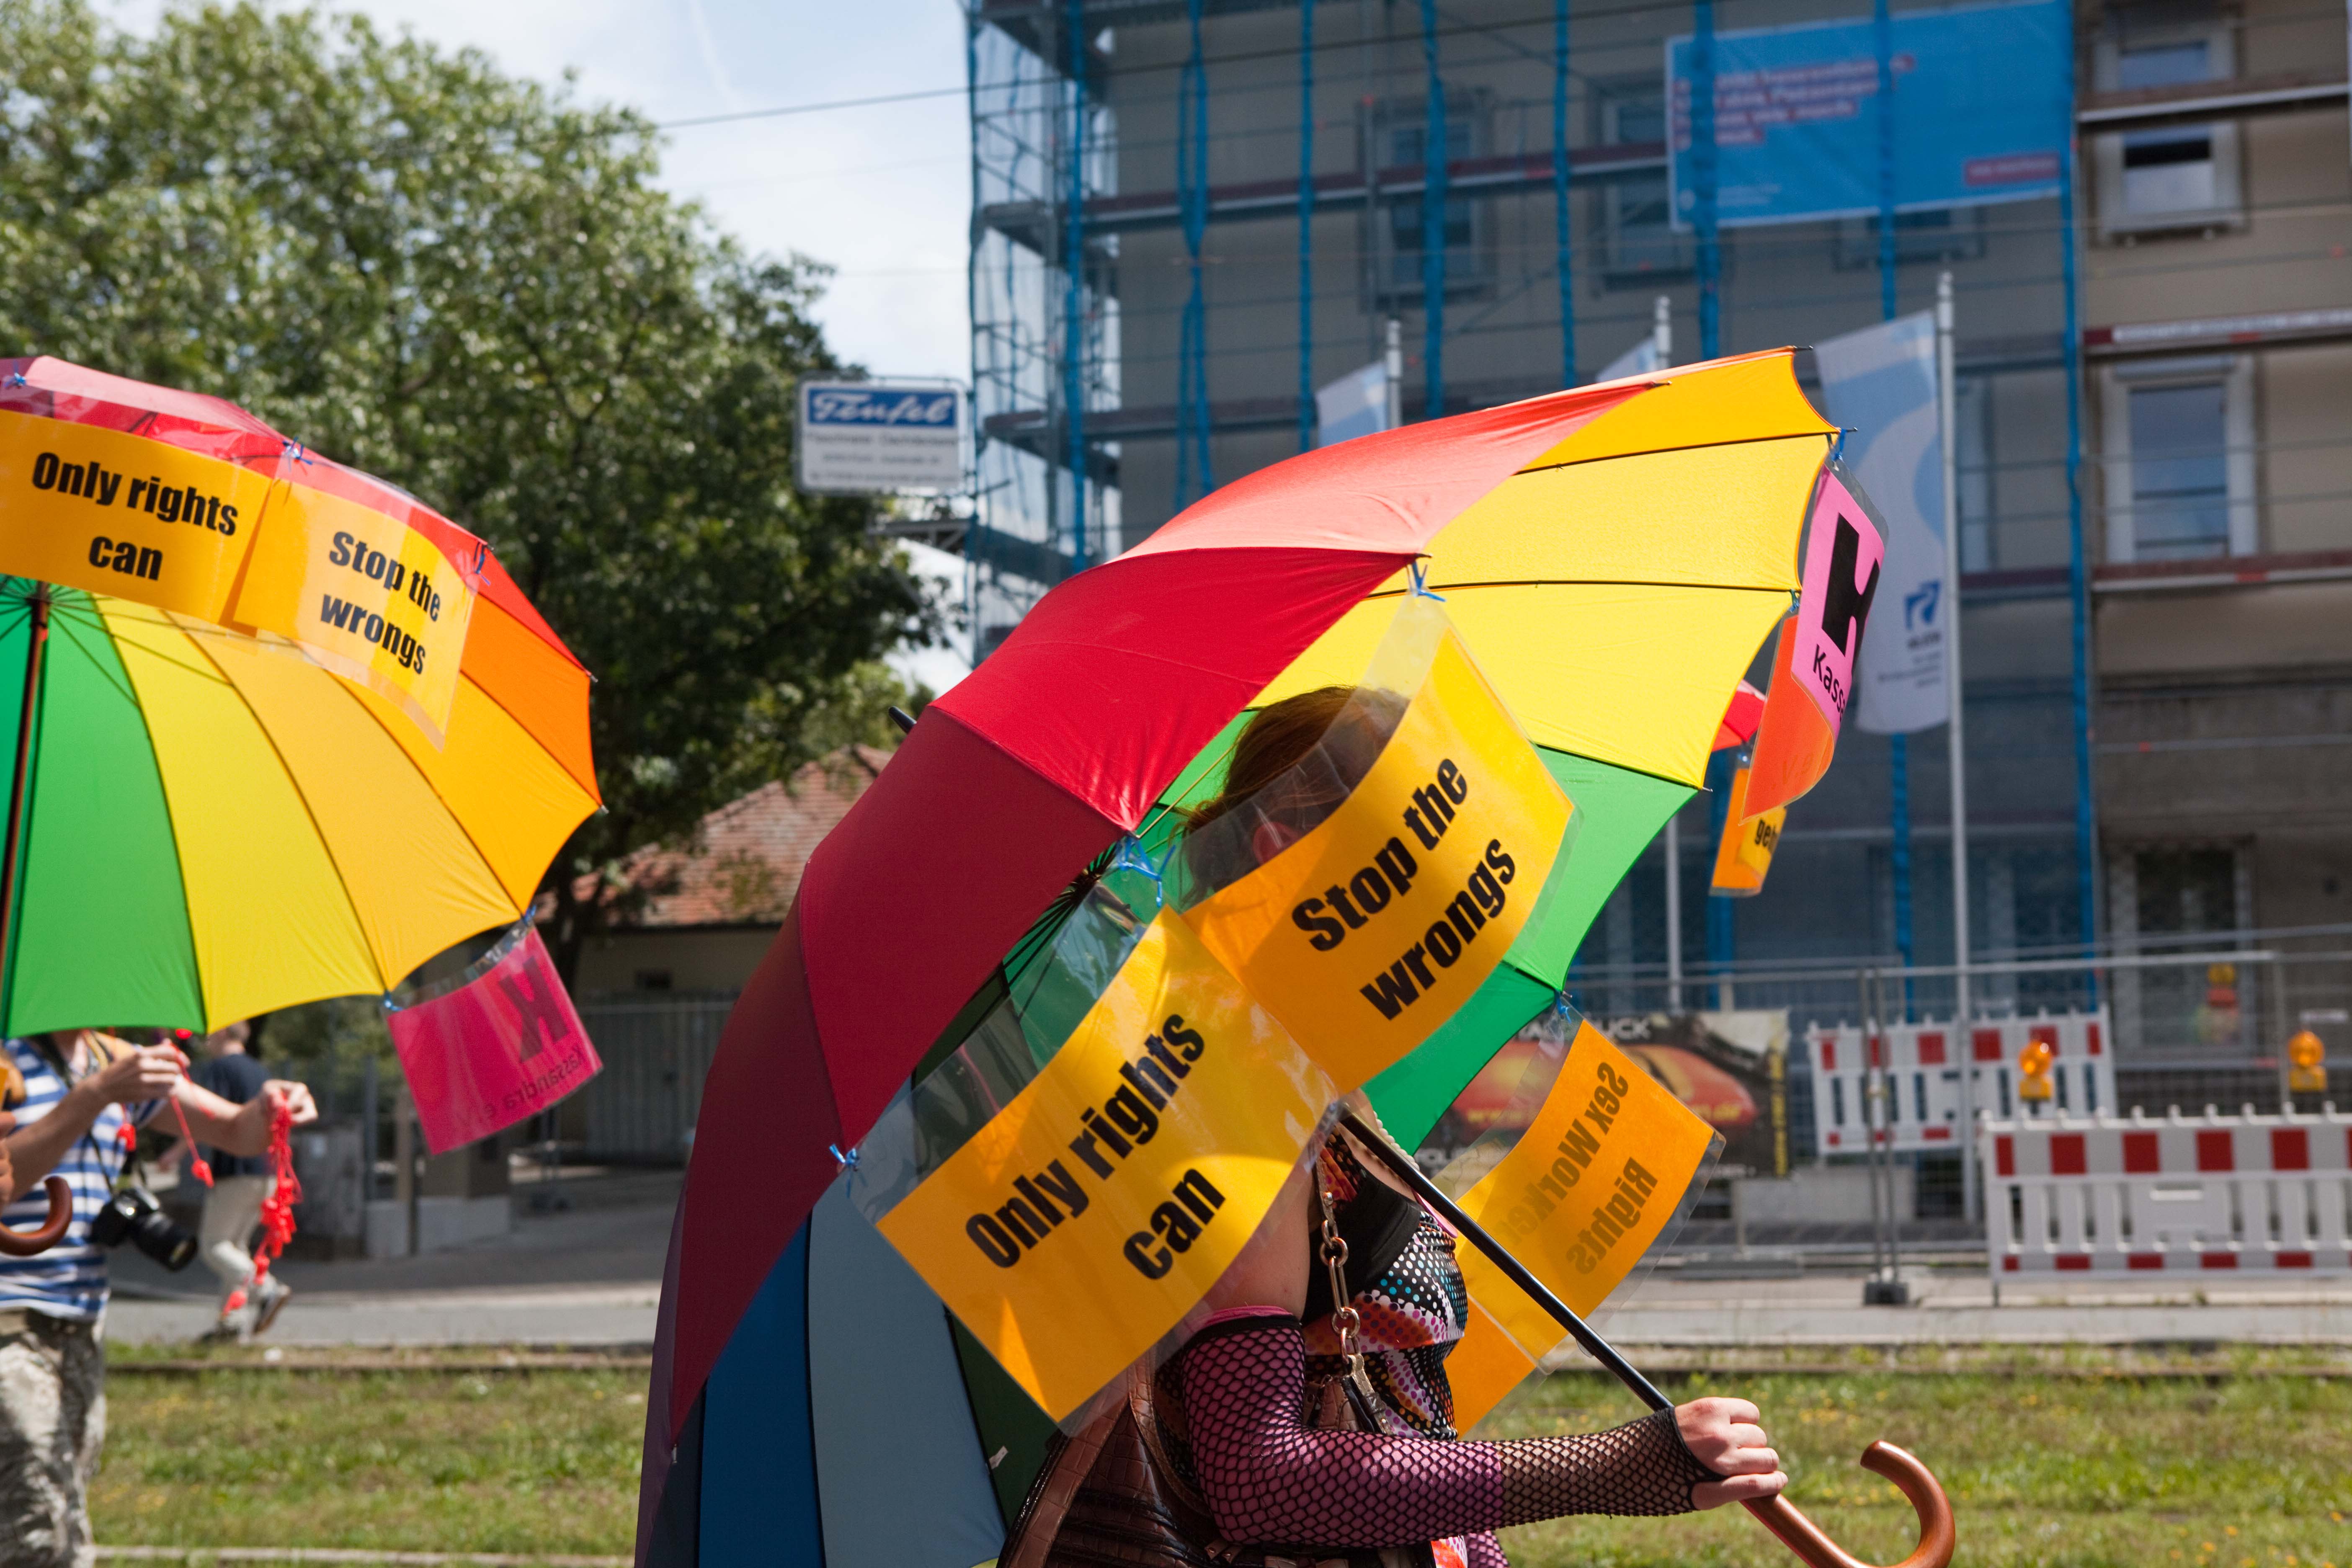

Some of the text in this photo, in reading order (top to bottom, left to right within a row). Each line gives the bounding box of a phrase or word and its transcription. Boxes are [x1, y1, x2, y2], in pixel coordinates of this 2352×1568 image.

[31, 451, 238, 536] Only rights
[88, 536, 163, 581] can
[329, 531, 441, 622] Stop the
[1821, 512, 1880, 666] K
[320, 593, 426, 675] wrongs
[1291, 758, 1468, 952] Stop the
[1359, 838, 1516, 1021] wrongs
[965, 1013, 1205, 1269] Only rights
[1122, 1168, 1227, 1281] can
